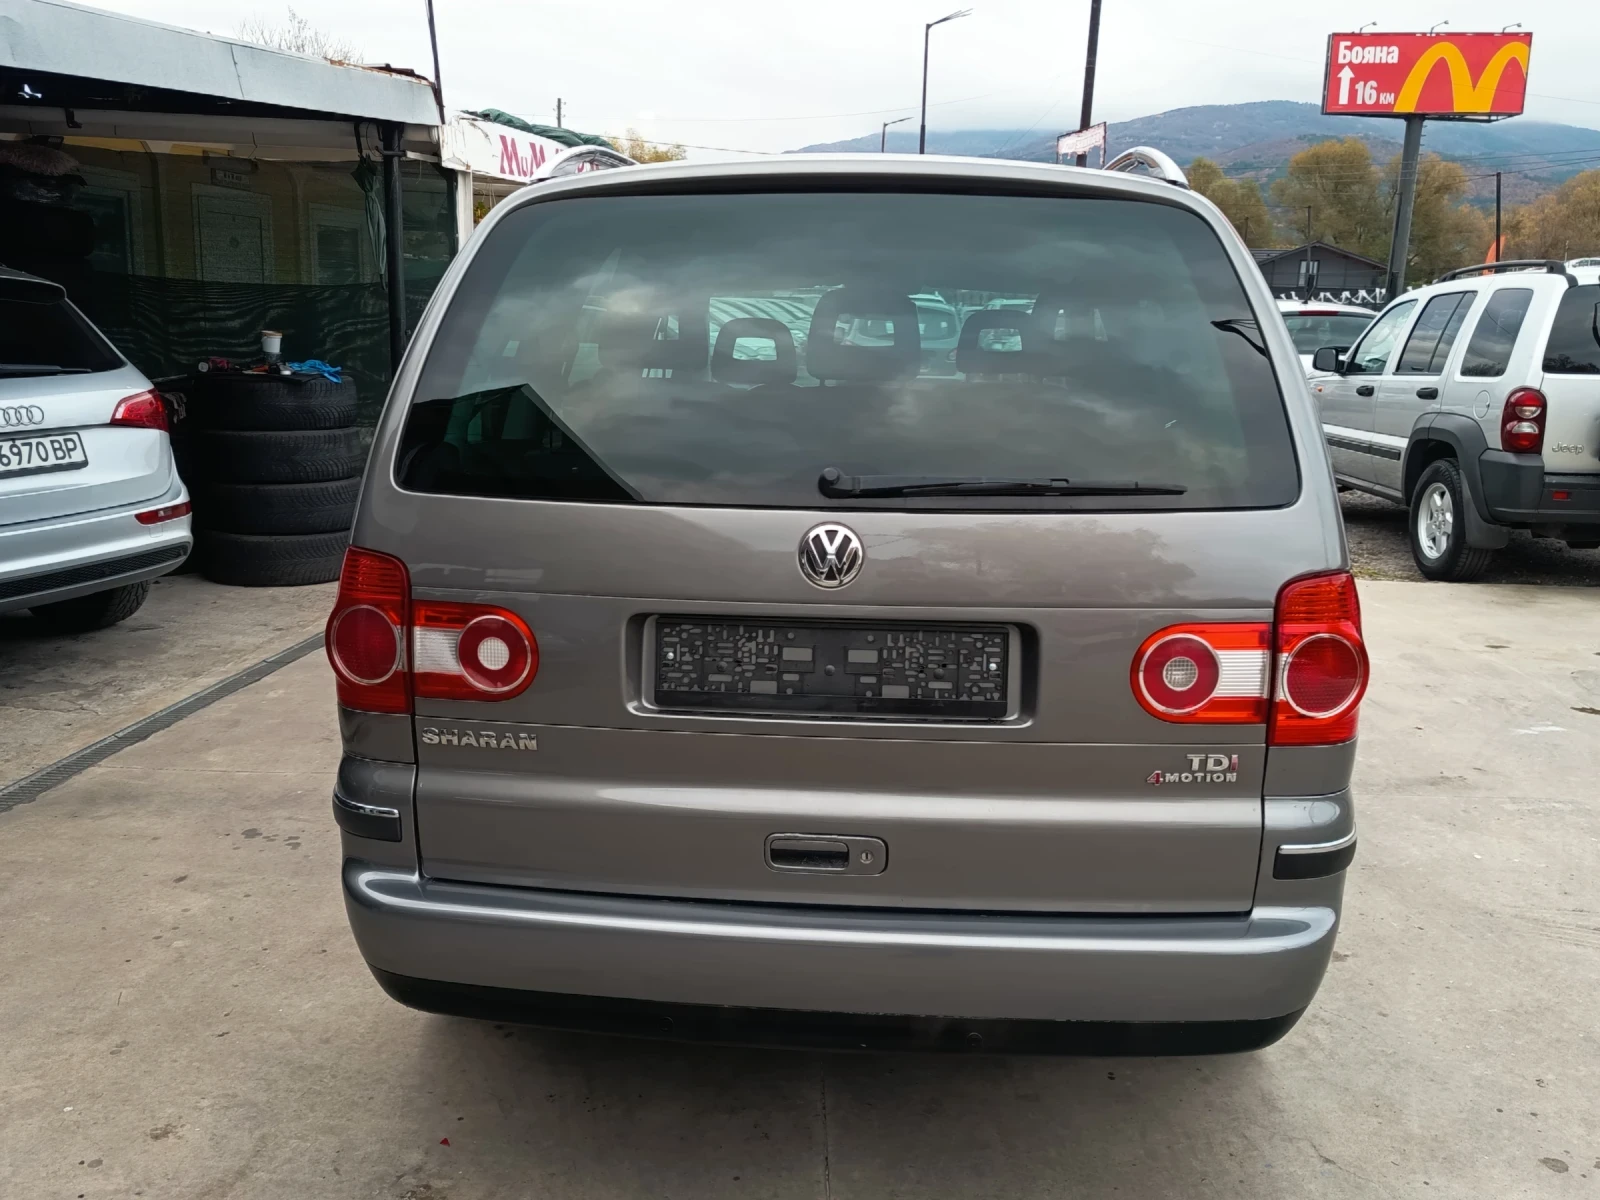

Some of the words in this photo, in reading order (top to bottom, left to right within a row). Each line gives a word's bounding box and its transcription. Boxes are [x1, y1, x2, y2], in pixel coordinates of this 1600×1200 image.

[1337, 41, 1399, 64] Бояна
[1355, 80, 1378, 105] 16
[1551, 441, 1584, 455] Jeep
[421, 727, 538, 750] SHARAN
[1186, 753, 1239, 771] TDI
